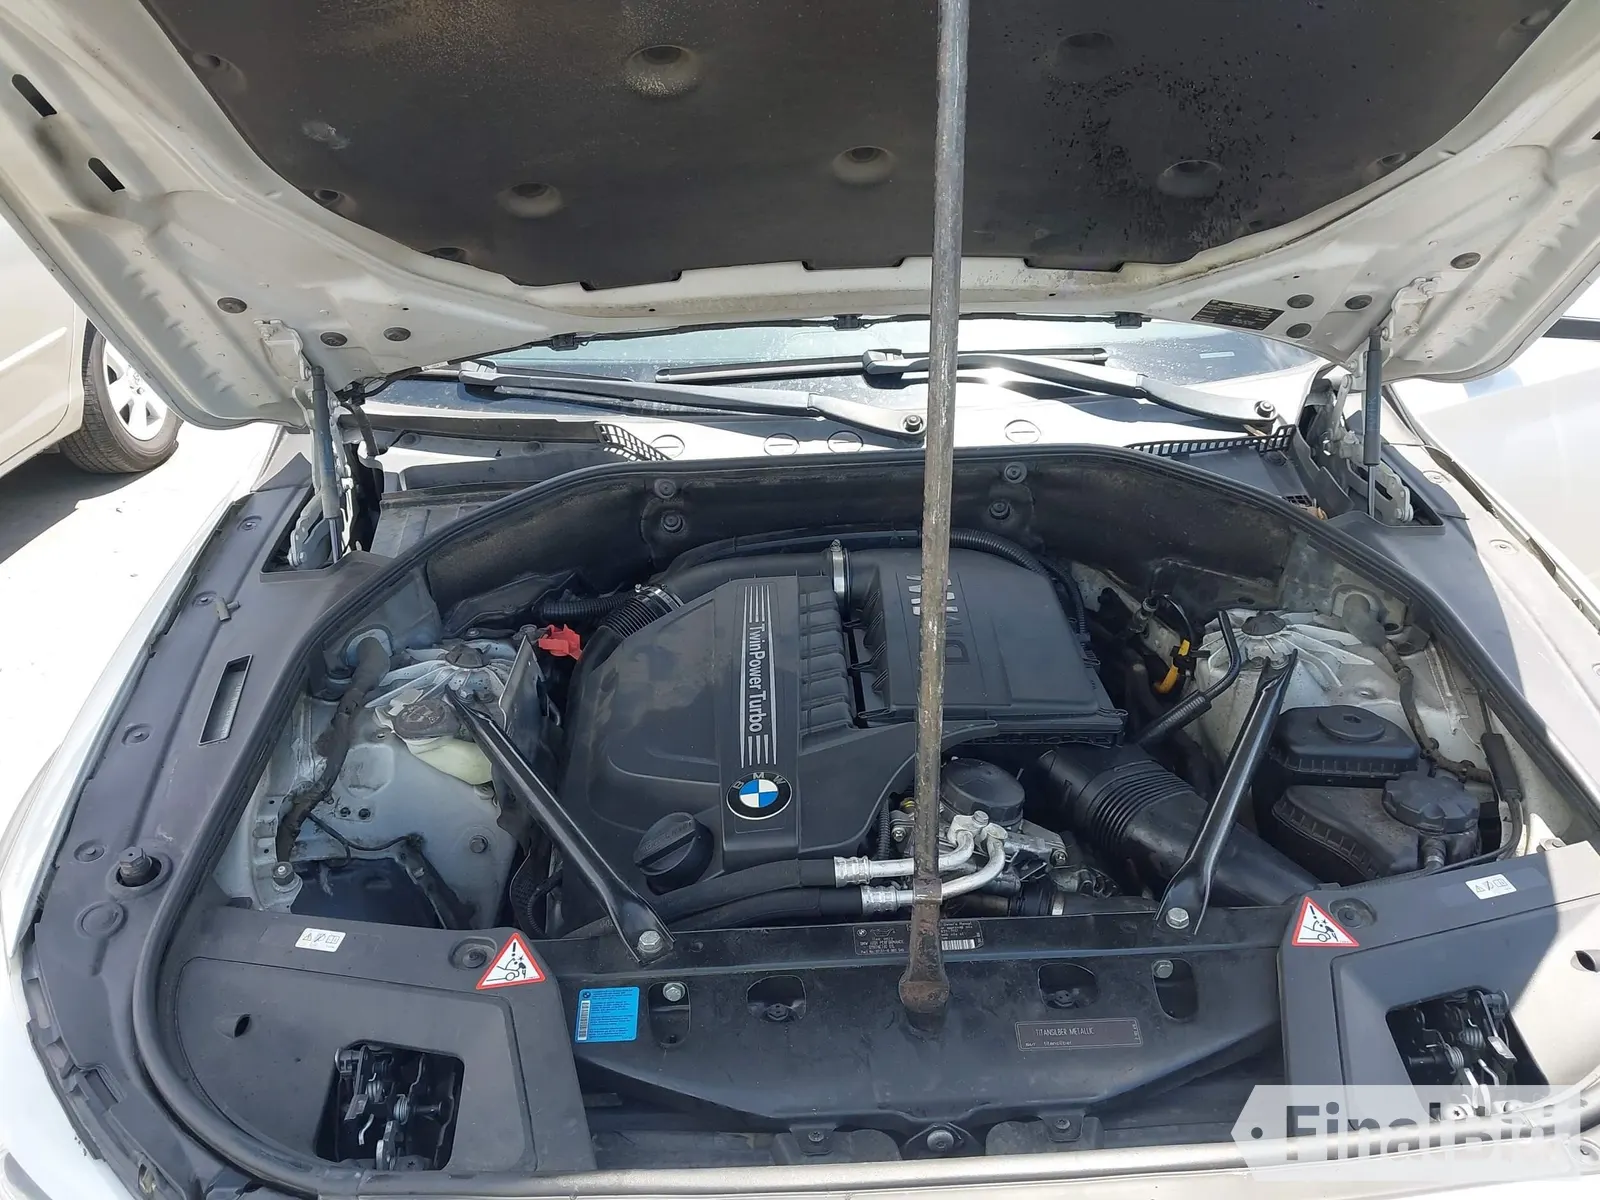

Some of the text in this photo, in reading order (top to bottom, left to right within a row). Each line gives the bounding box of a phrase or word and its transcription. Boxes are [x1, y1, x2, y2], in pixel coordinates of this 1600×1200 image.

[748, 624, 767, 733] TwinPower Turbo
[733, 771, 786, 790] BMW
